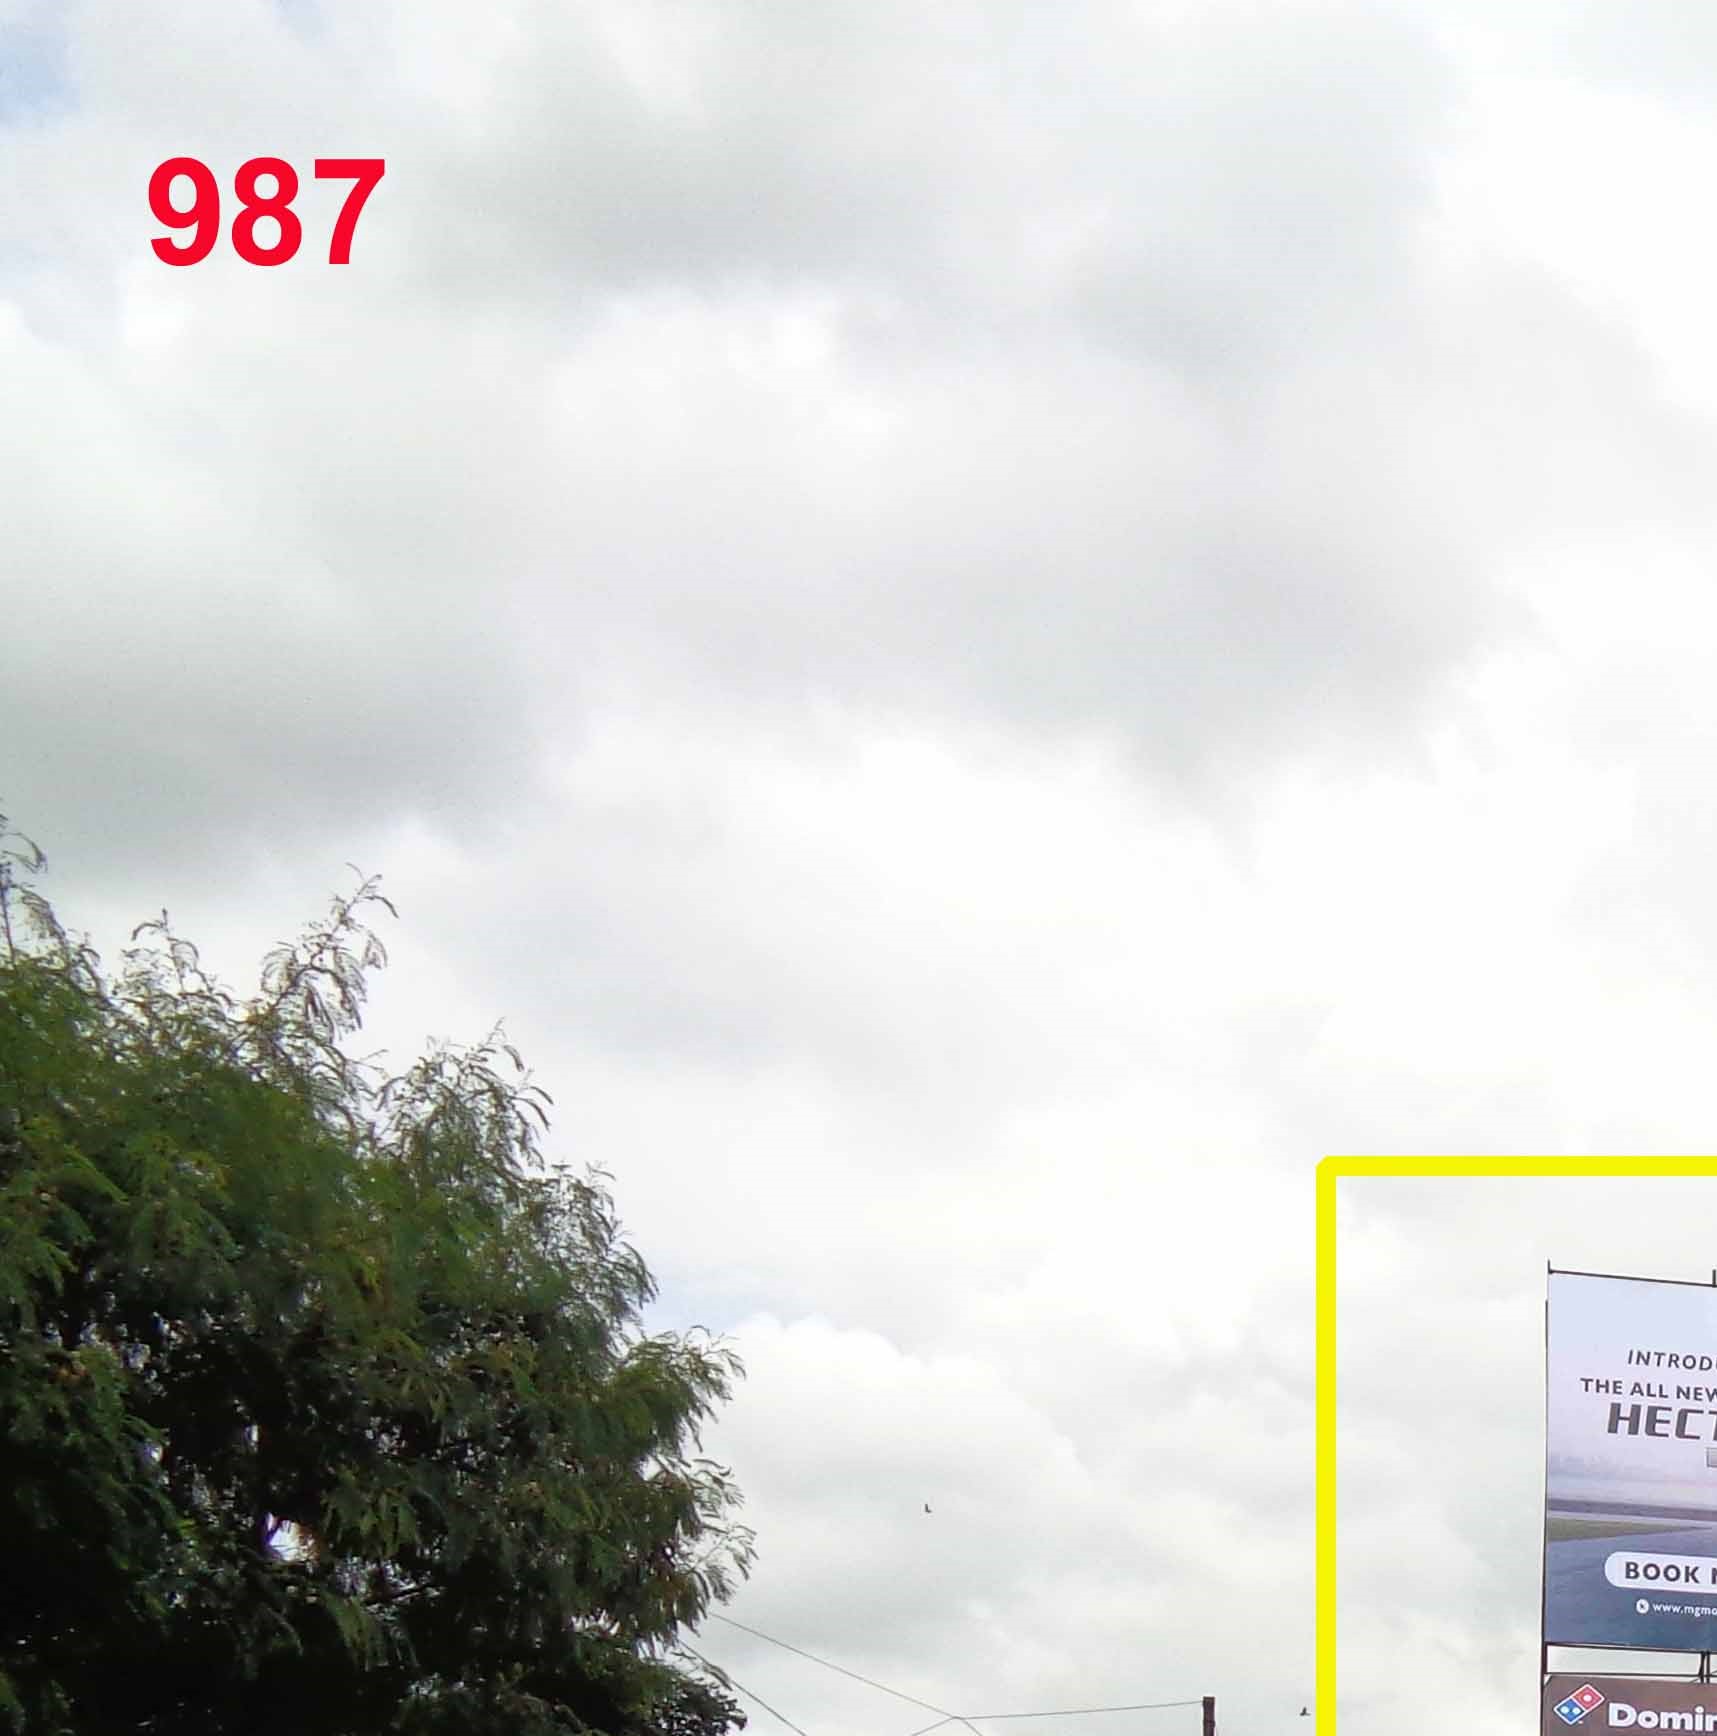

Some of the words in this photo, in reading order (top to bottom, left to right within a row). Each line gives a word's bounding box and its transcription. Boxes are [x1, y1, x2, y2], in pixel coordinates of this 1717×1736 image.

[1580, 1377, 1624, 1395] THE
[1630, 1382, 1669, 1399] ALL
[1625, 1561, 1700, 1584] BOOK
